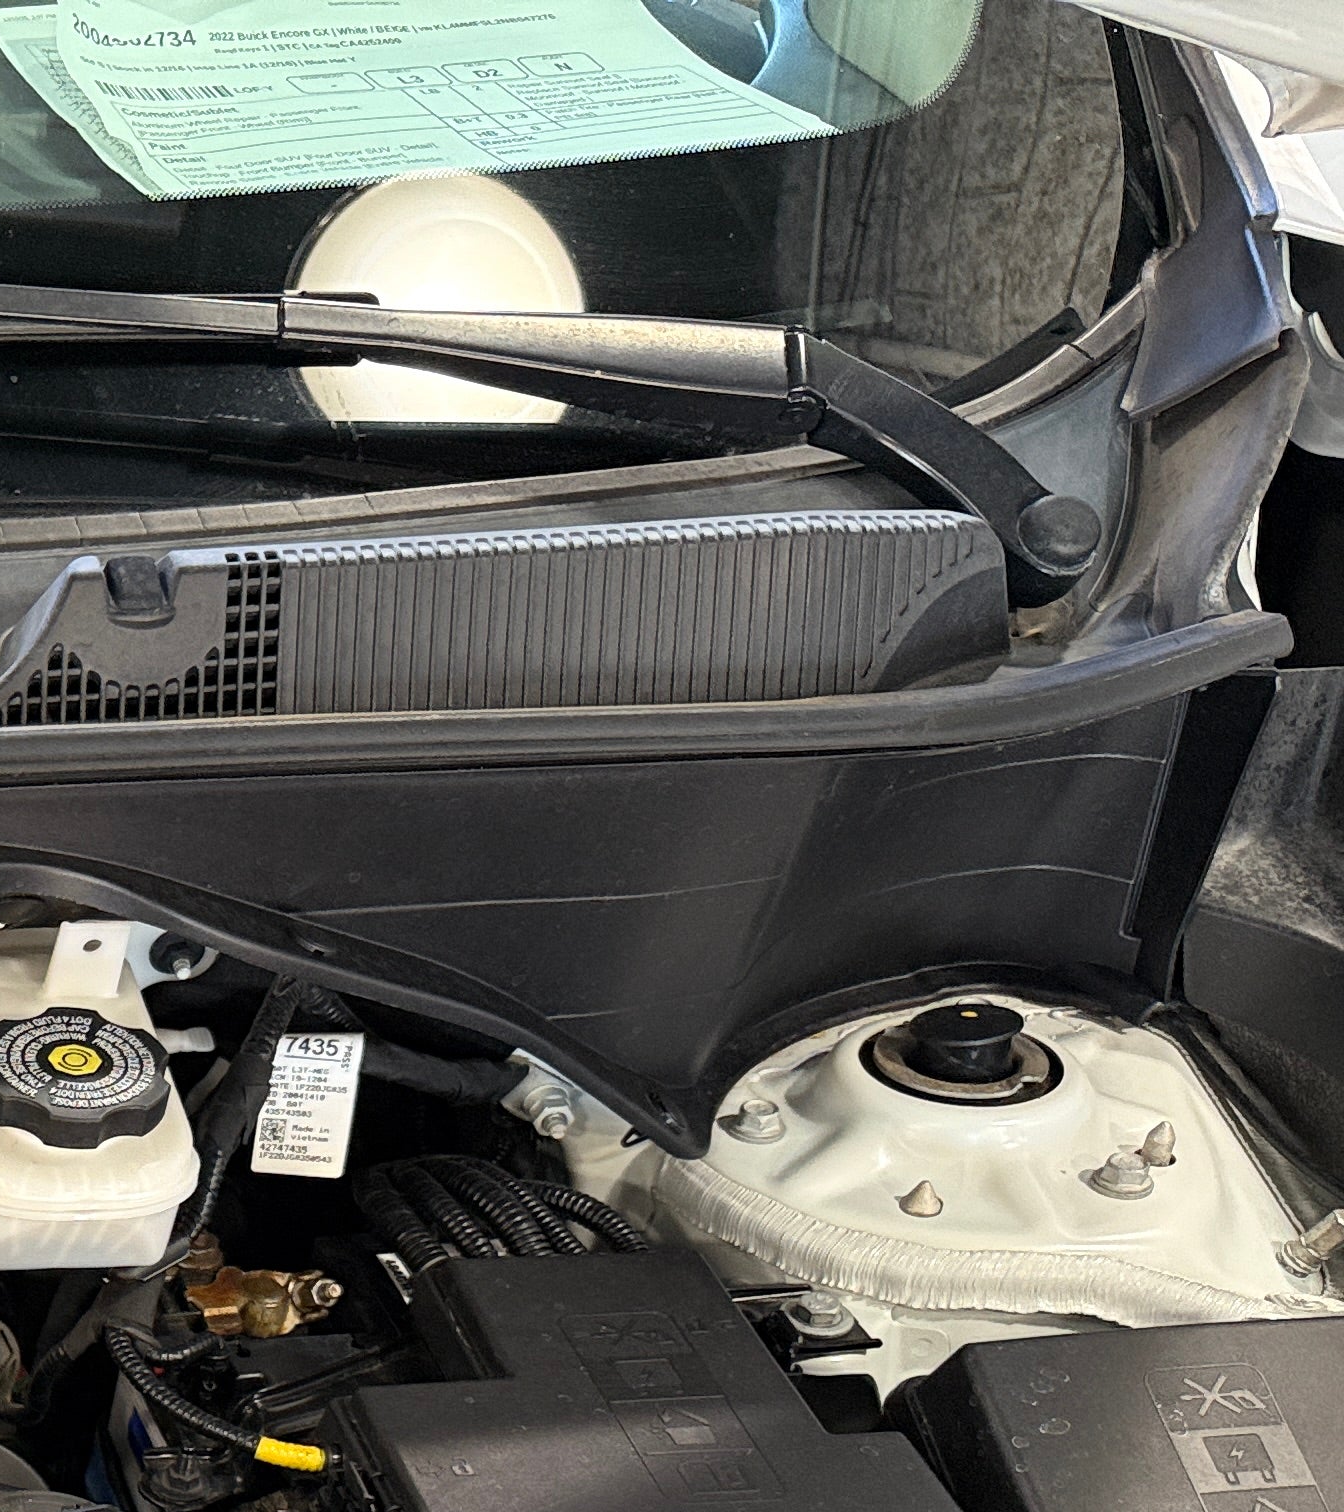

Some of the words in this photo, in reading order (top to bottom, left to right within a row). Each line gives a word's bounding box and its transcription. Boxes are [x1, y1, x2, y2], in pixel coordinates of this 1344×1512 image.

[208, 31, 235, 42] 2022
[237, 30, 269, 41] Buick
[271, 28, 311, 40] Encore
[313, 28, 329, 37] GX
[337, 26, 368, 36] White
[376, 24, 411, 34] BEIGE
[554, 62, 573, 72] N
[472, 68, 504, 79] D2
[120, 106, 240, 119] Cosmetic/Sublet
[148, 142, 188, 151] Paint
[162, 155, 206, 164] Detail
[69, 1016, 92, 1026] DOT
[285, 1036, 340, 1056] 7435
